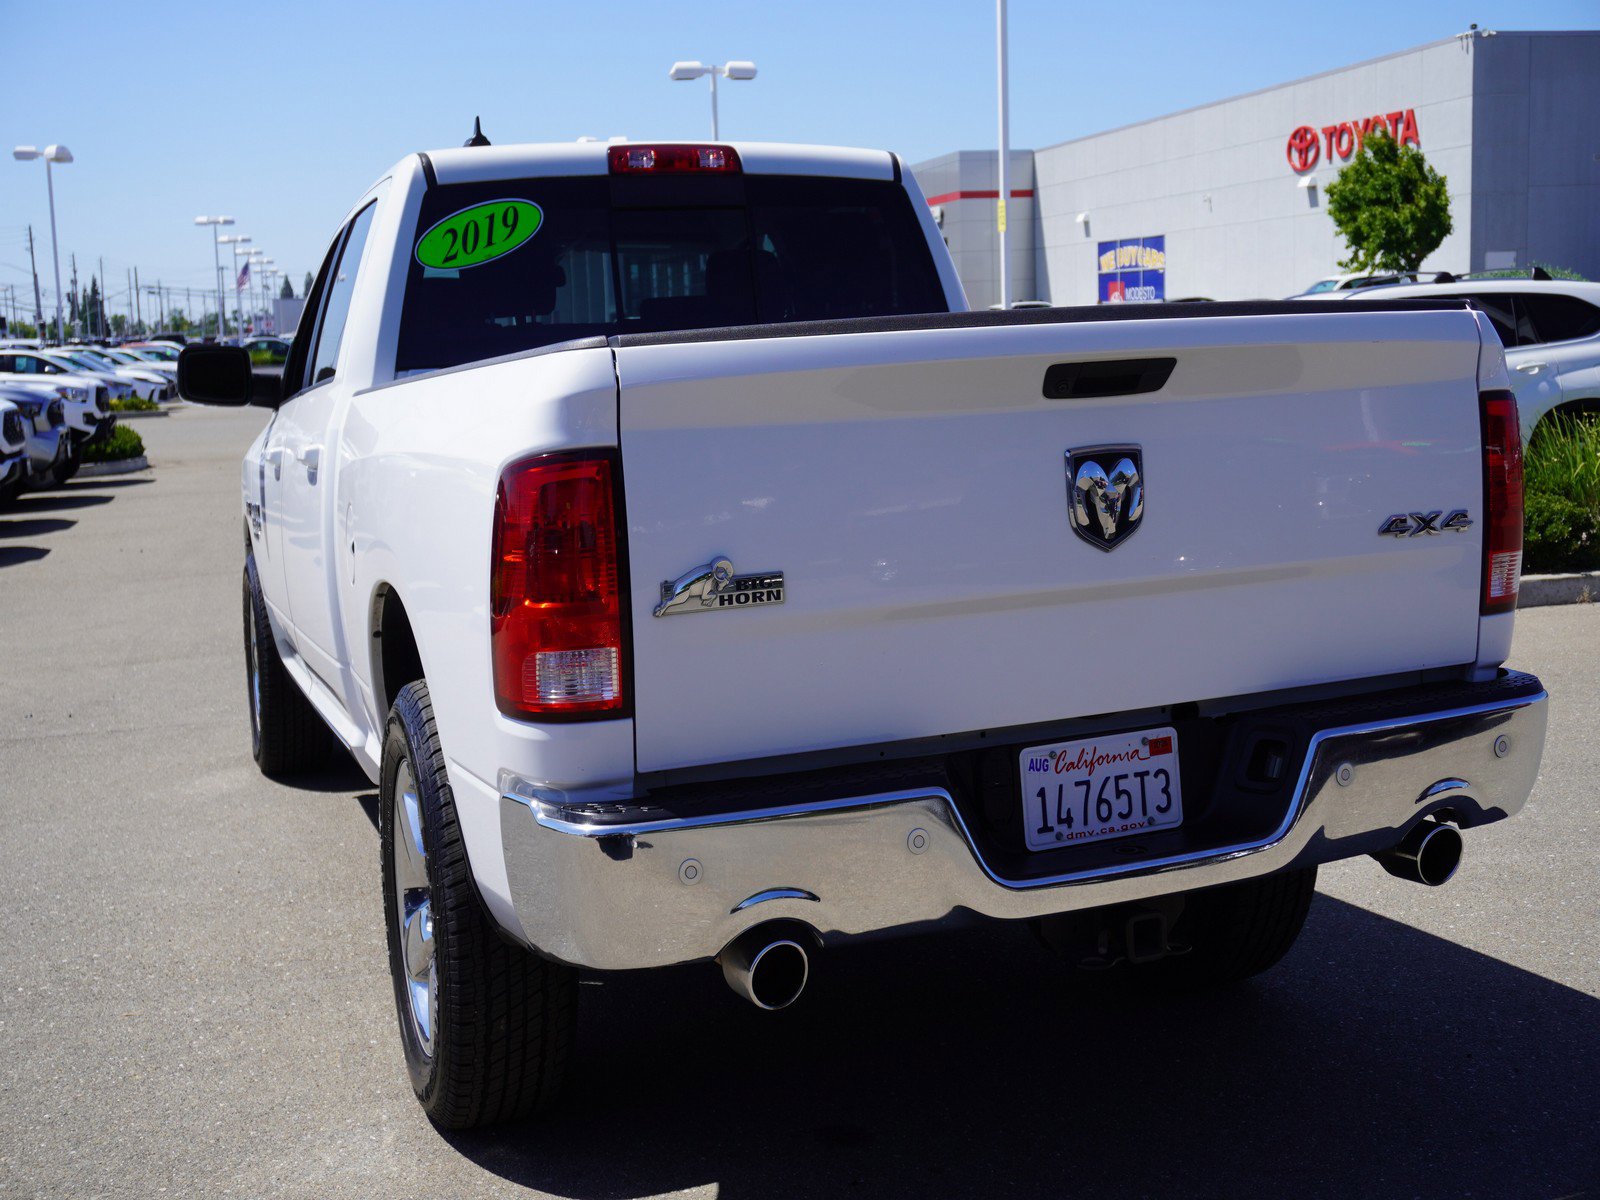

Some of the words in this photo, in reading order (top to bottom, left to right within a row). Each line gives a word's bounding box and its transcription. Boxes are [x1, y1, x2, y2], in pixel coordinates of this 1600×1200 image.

[1321, 108, 1419, 161] TOYOTA
[441, 205, 519, 264] 2019
[1100, 249, 1116, 272] WE
[1125, 286, 1156, 301] MODESTO
[735, 575, 775, 591] BIG
[718, 589, 782, 607] HORN
[1028, 757, 1050, 773] AUG
[1054, 744, 1150, 777] California
[1037, 768, 1172, 835] 14765T3
[1066, 821, 1146, 840] dmv.ca.gov
